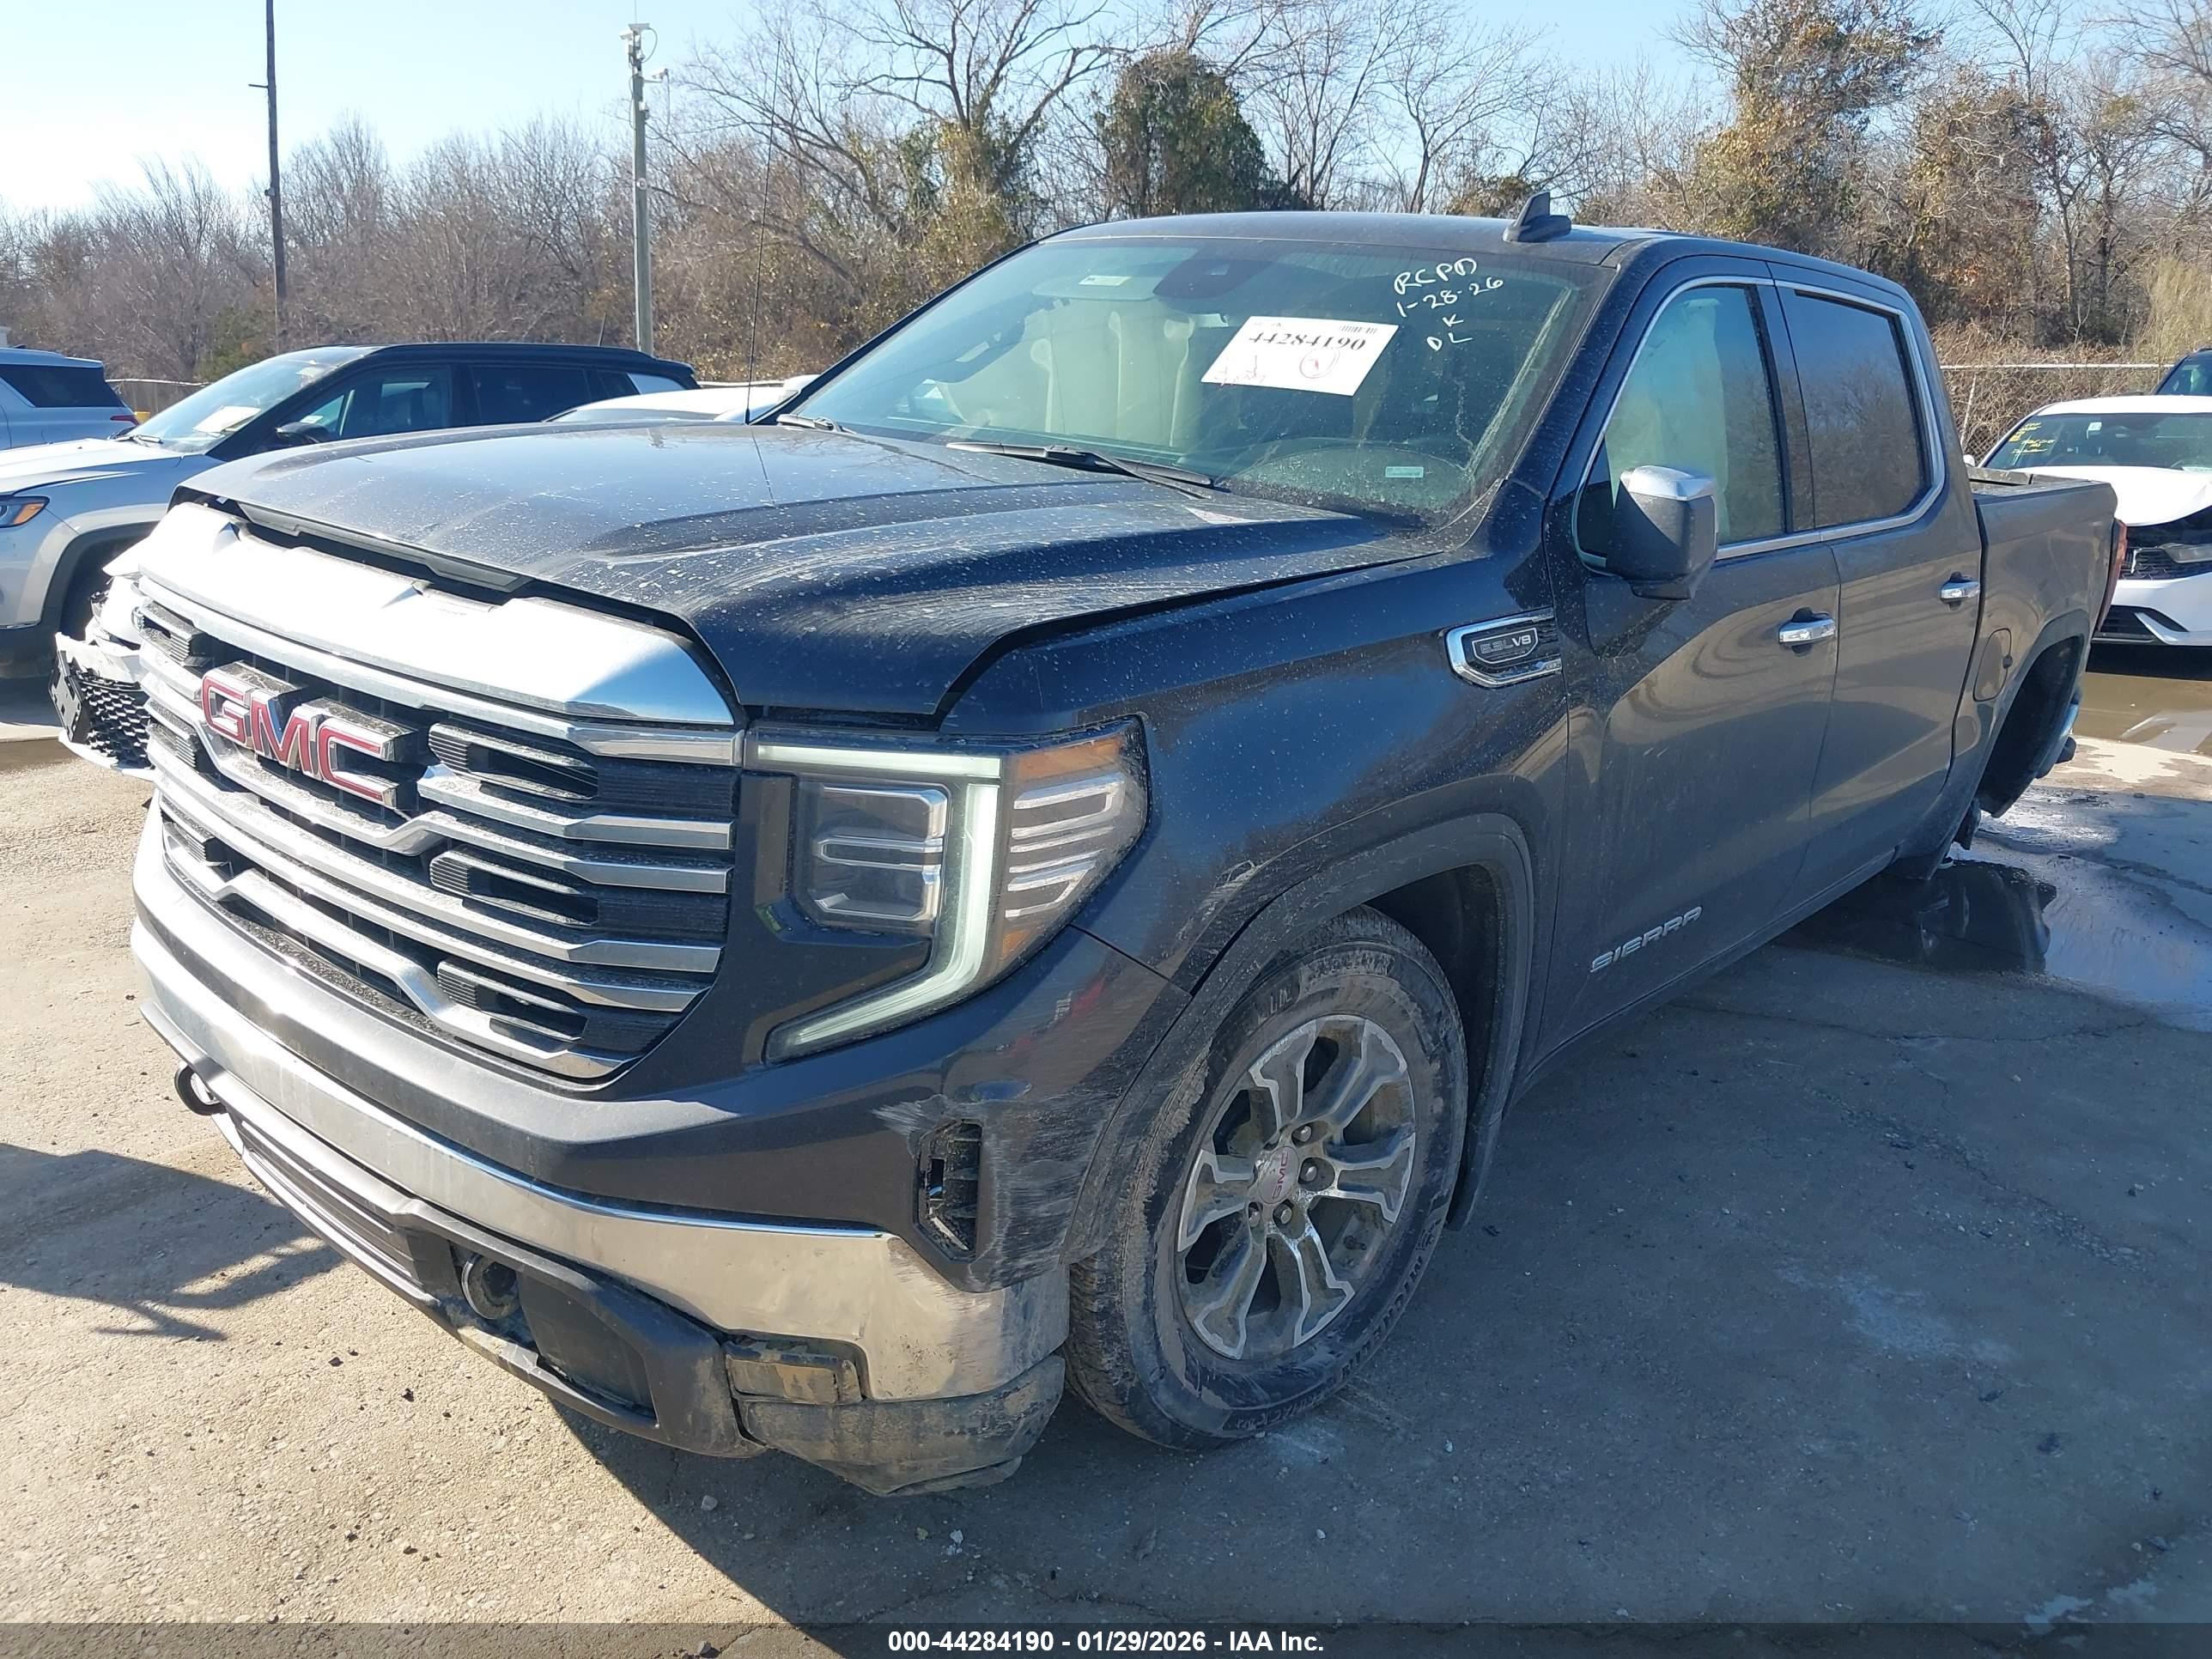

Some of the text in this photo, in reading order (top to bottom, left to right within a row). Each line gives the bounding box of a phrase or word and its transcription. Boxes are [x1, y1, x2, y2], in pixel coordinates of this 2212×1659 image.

[1396, 276, 1504, 318] 1-28-26
[1249, 331, 1366, 351] 44284190
[1511, 634, 1533, 647] V8
[202, 670, 395, 809] GMC
[1589, 906, 1702, 973] SIERRA
[1273, 1152, 1290, 1200] GMC
